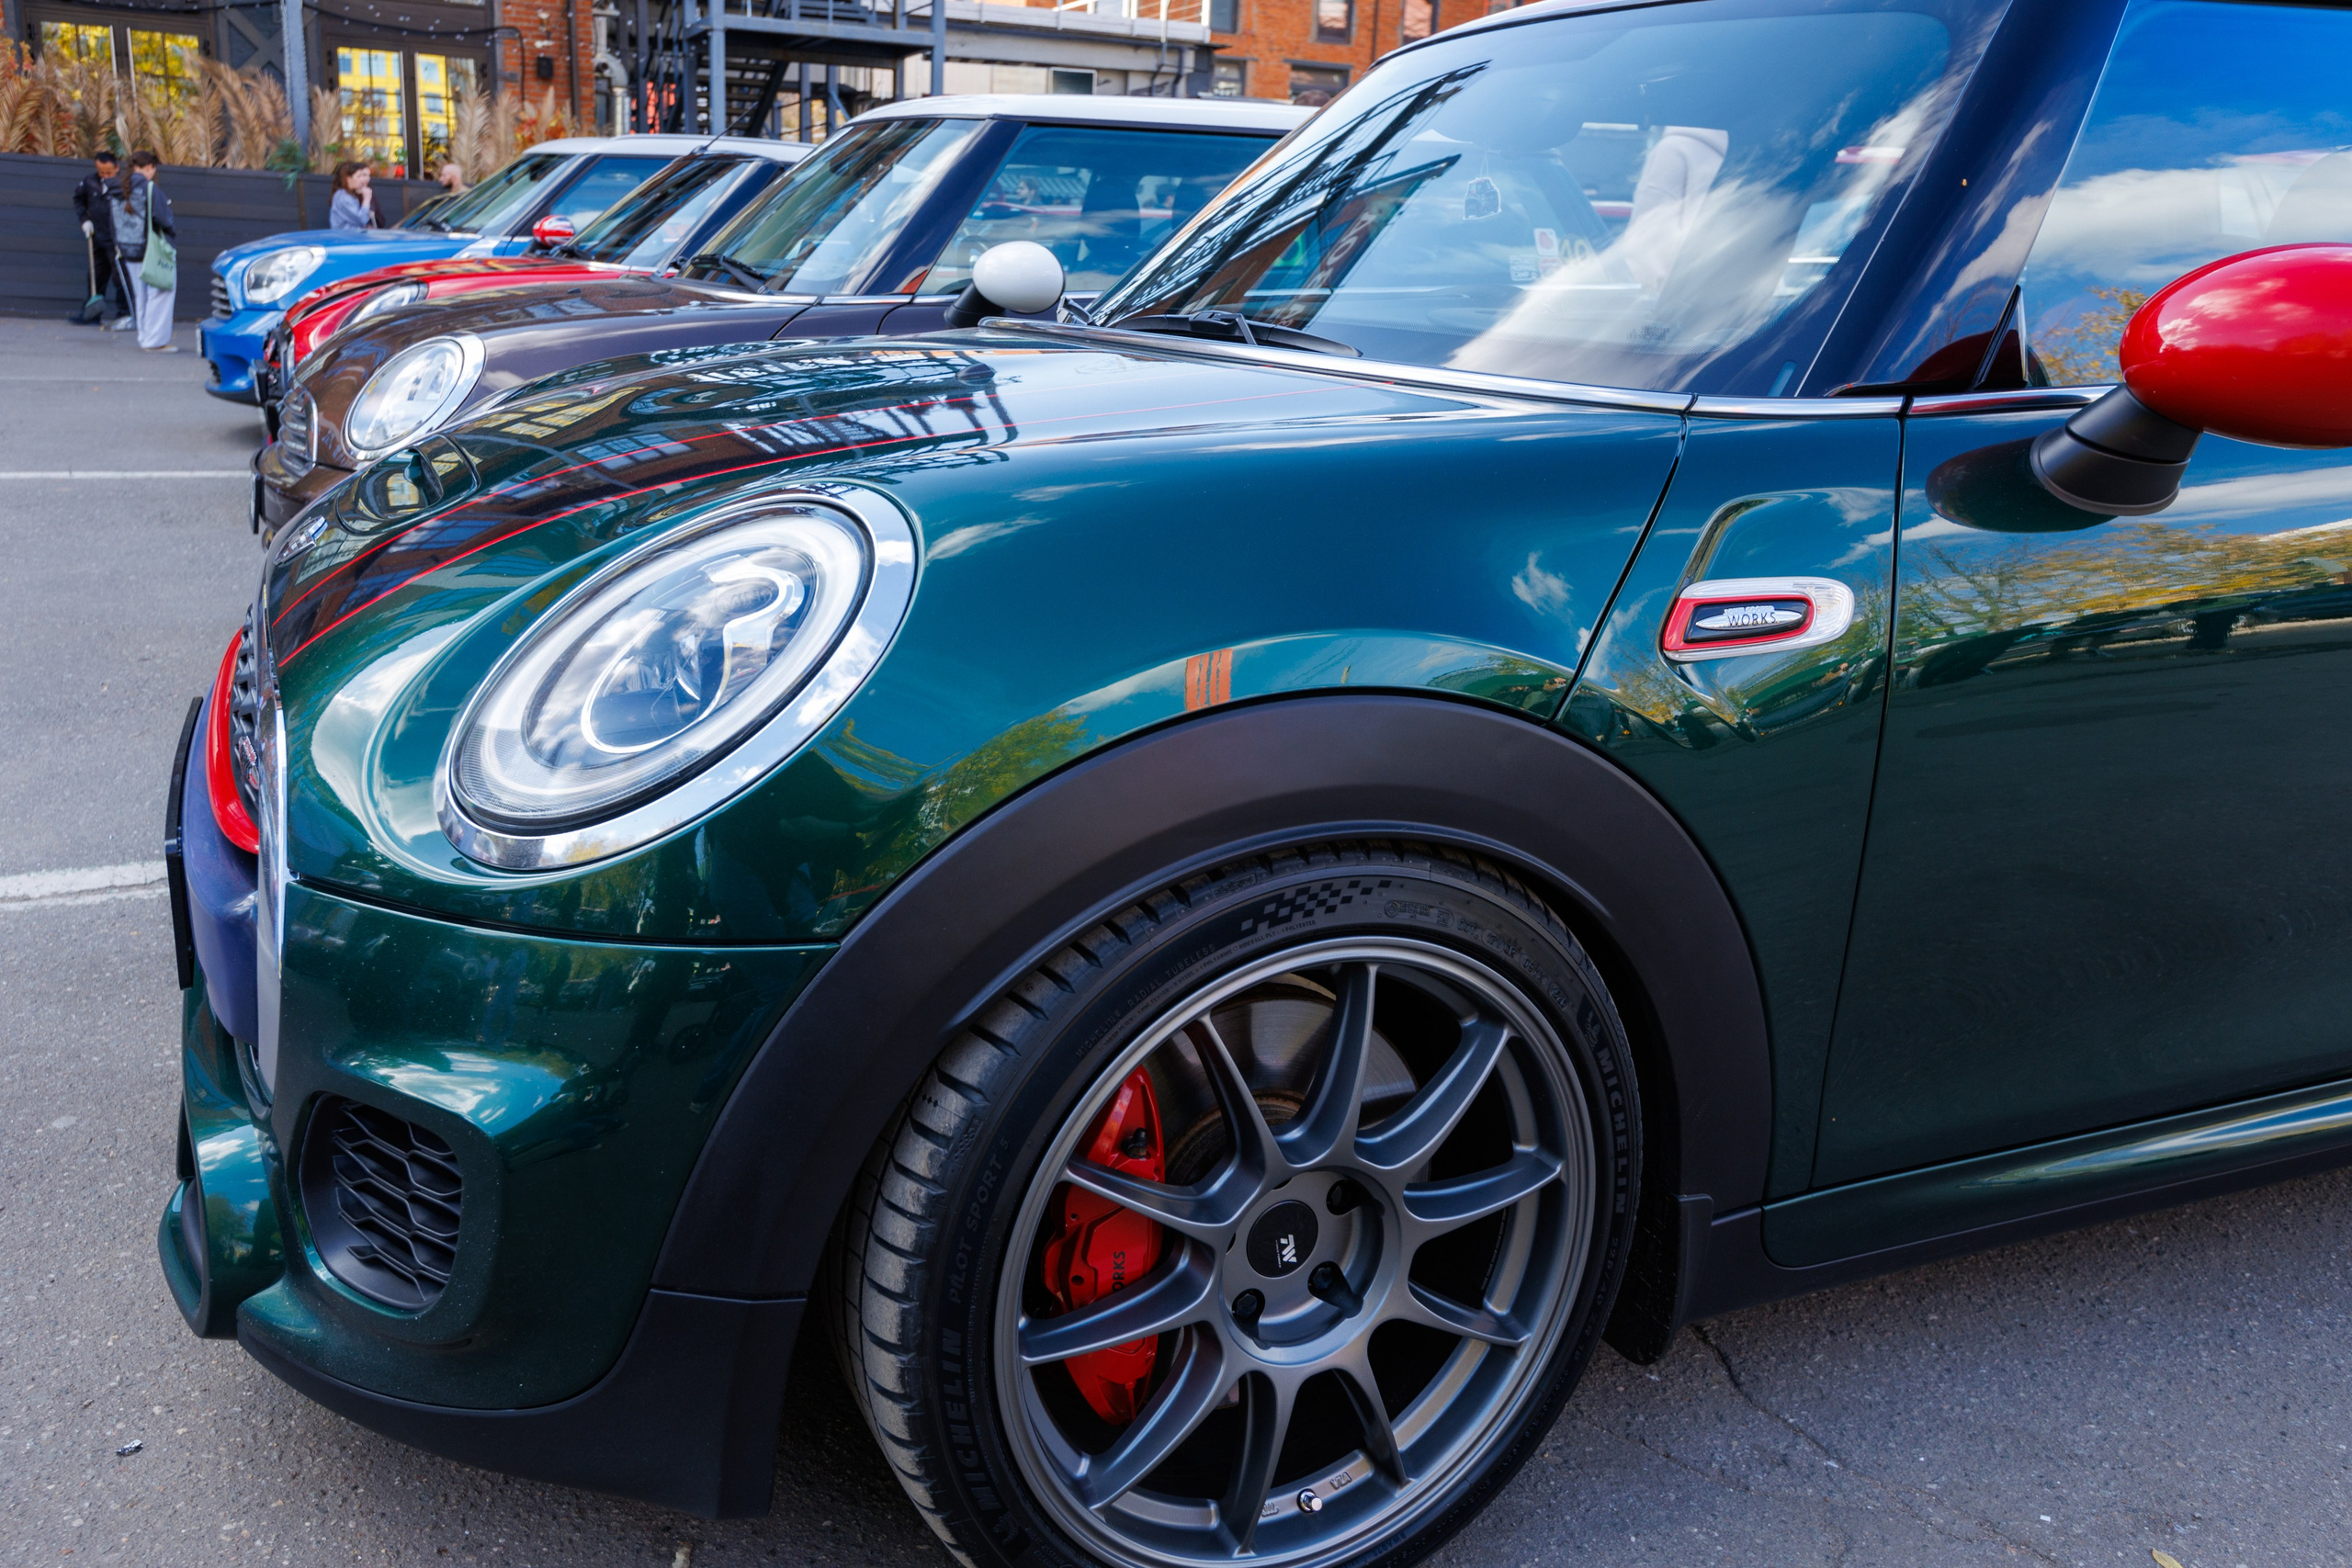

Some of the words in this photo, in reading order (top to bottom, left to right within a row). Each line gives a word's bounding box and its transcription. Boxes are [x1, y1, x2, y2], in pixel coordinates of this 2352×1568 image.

[1728, 612, 1776, 626] WORKS
[1285, 919, 1316, 931] POLYESTER
[1127, 979, 1162, 1008] RADIAL
[1164, 943, 1216, 978] TUBELESS
[1596, 1049, 1627, 1214] MICHELIN
[948, 1235, 973, 1304] PILOT
[967, 1154, 1002, 1233] SPORT
[1001, 1138, 1009, 1150] 5
[1112, 1250, 1126, 1292] ORKS
[942, 1326, 1001, 1511] MICHELIN
